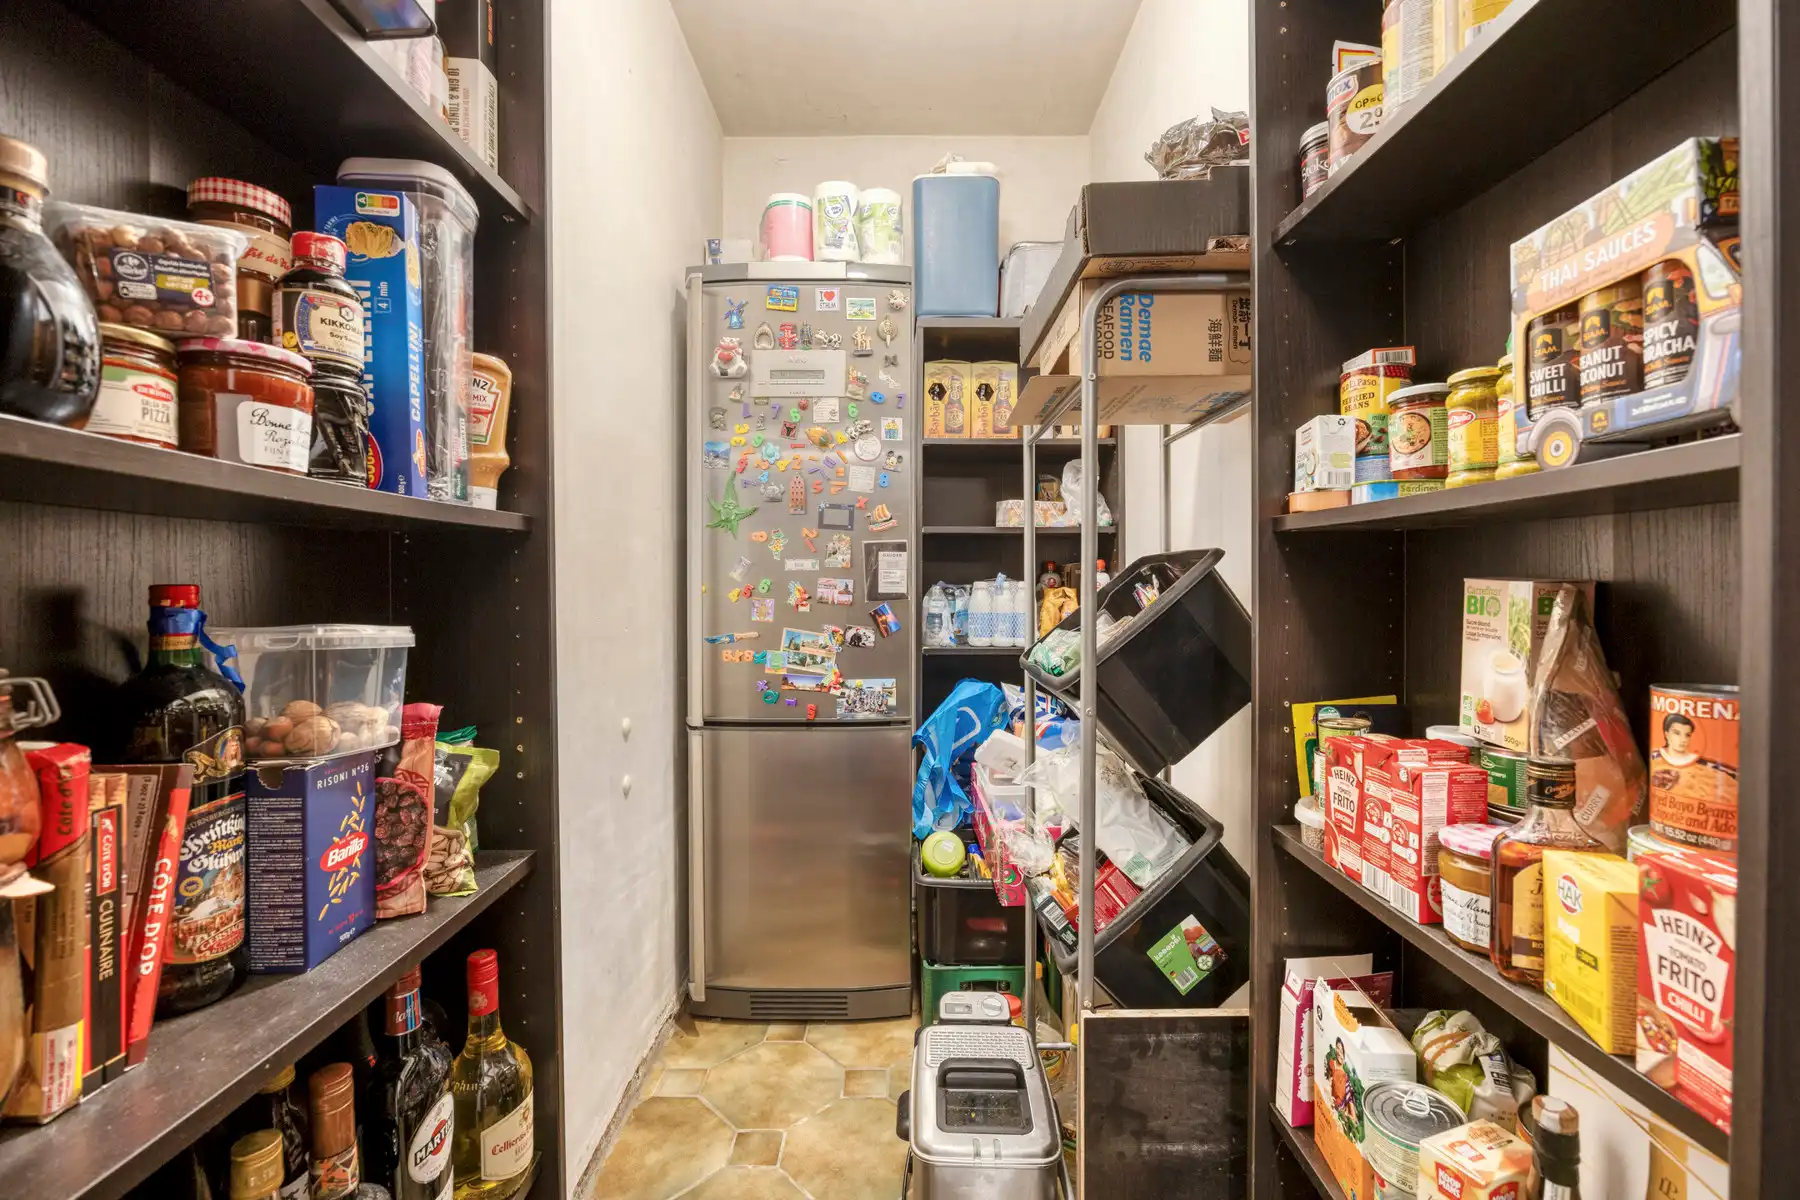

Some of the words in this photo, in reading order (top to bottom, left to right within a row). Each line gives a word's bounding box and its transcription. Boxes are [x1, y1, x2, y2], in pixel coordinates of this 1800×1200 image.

[448, 78, 460, 92] GIN
[448, 102, 460, 126] TONIC
[1540, 261, 1578, 292] THAI
[1583, 221, 1657, 272] SAUCES
[377, 281, 389, 297] min
[329, 331, 343, 341] Soy
[1103, 297, 1115, 360] SEAFOOD
[1119, 293, 1136, 361] Ramen
[1138, 293, 1155, 363] Demae
[408, 320, 422, 422] CAPELLINI
[1530, 363, 1566, 384] SWEET
[1530, 379, 1566, 398] CHILLI
[141, 408, 172, 426] PIZZA
[1344, 400, 1371, 413] BEANS
[249, 407, 293, 432] Bonne
[1399, 482, 1440, 494] Sardines
[1466, 595, 1502, 618] BIO
[1652, 694, 1741, 721] MOREN
[316, 774, 349, 790] RISONI
[1333, 769, 1356, 788] HEINZ
[1332, 792, 1356, 813] FRITO
[1580, 792, 1603, 822] CURRY
[1668, 796, 1695, 814] Bayo
[1696, 801, 1737, 820] Beans
[1685, 815, 1709, 831] and
[1710, 818, 1737, 834] Ado
[327, 837, 366, 868] Barilla
[147, 857, 173, 916] CÔTE
[1557, 879, 1583, 913] HAK
[98, 899, 114, 982] CULINAIRE
[1659, 914, 1717, 954] HEINZ
[139, 922, 162, 977] D'OR
[1668, 944, 1708, 973] TOMATO
[1657, 954, 1716, 1002] FRITO
